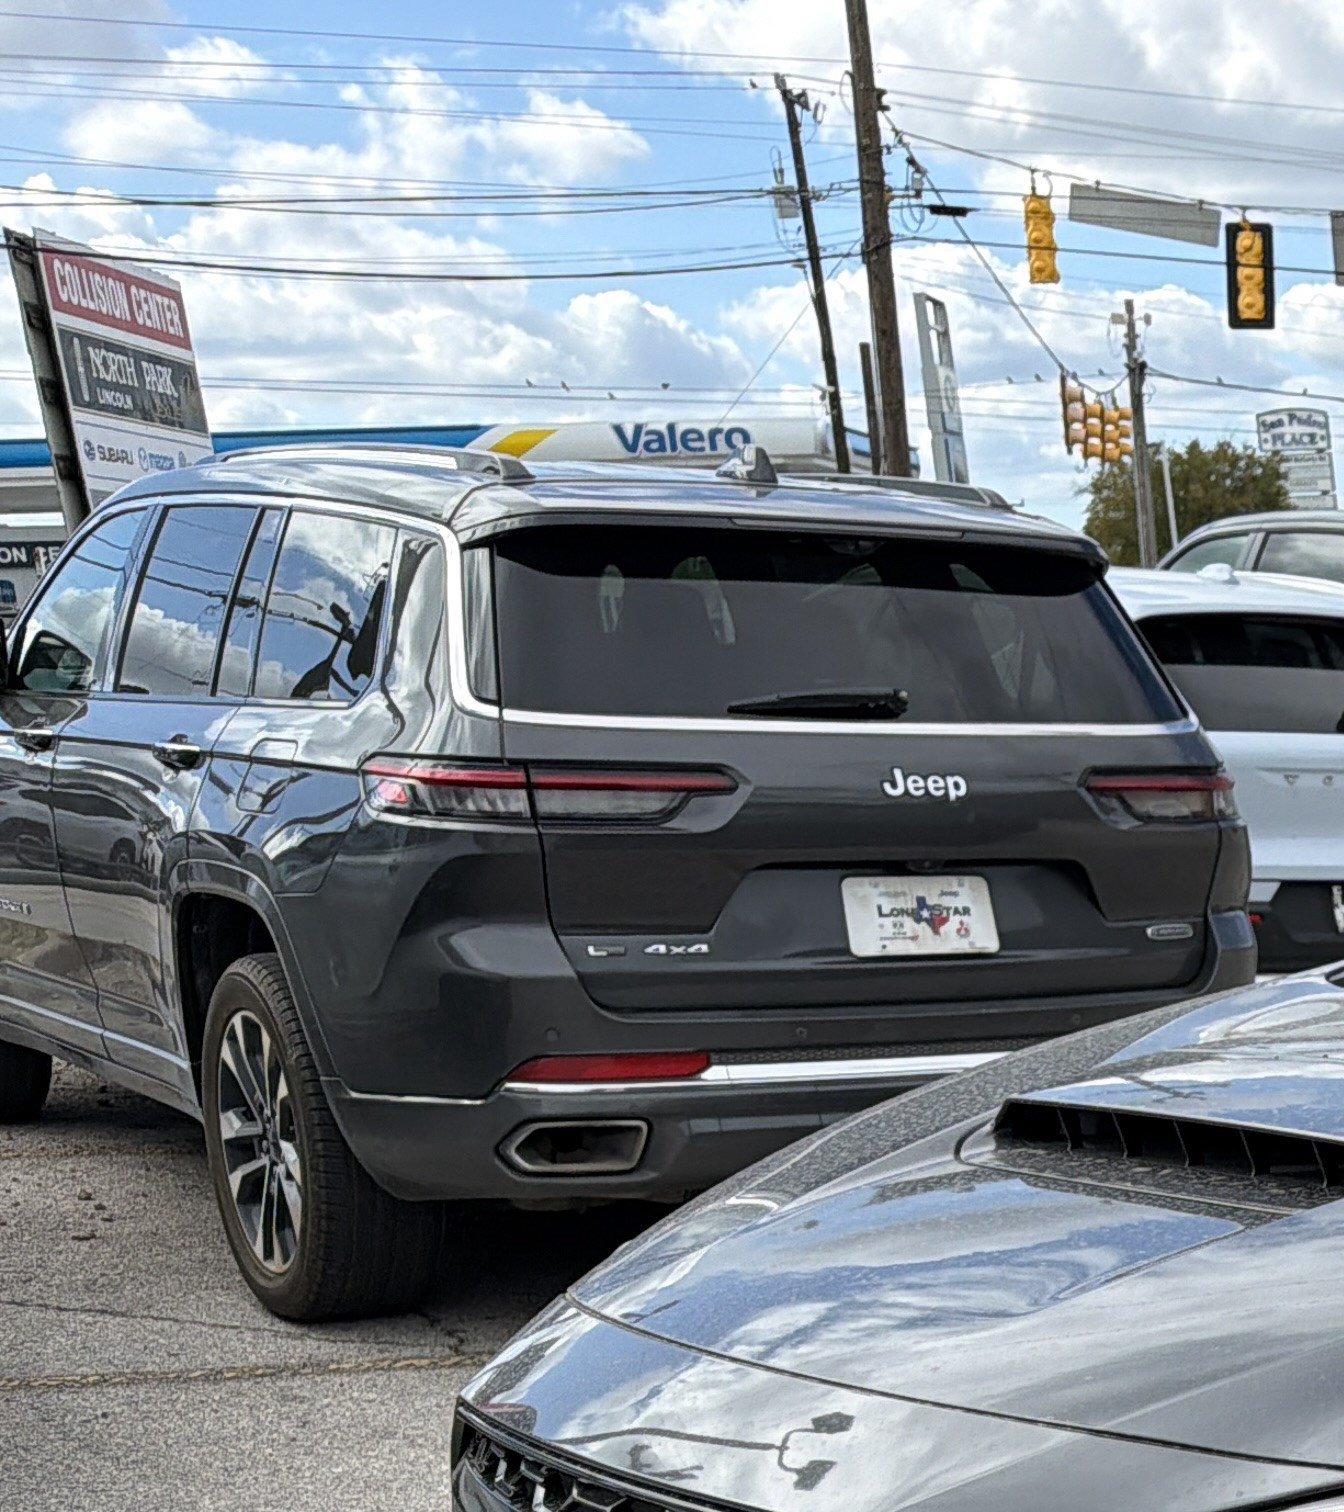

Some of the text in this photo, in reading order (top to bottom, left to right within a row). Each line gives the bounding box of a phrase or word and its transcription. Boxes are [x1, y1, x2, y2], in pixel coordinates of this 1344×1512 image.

[53, 258, 184, 338] COLLISION CENTER
[88, 346, 178, 398] NORTH PARK
[97, 387, 133, 410] LINCOLN
[610, 422, 752, 453] Valero
[97, 444, 134, 465] SUBARU
[882, 767, 967, 801] Jeep
[644, 944, 709, 955] 4x4
